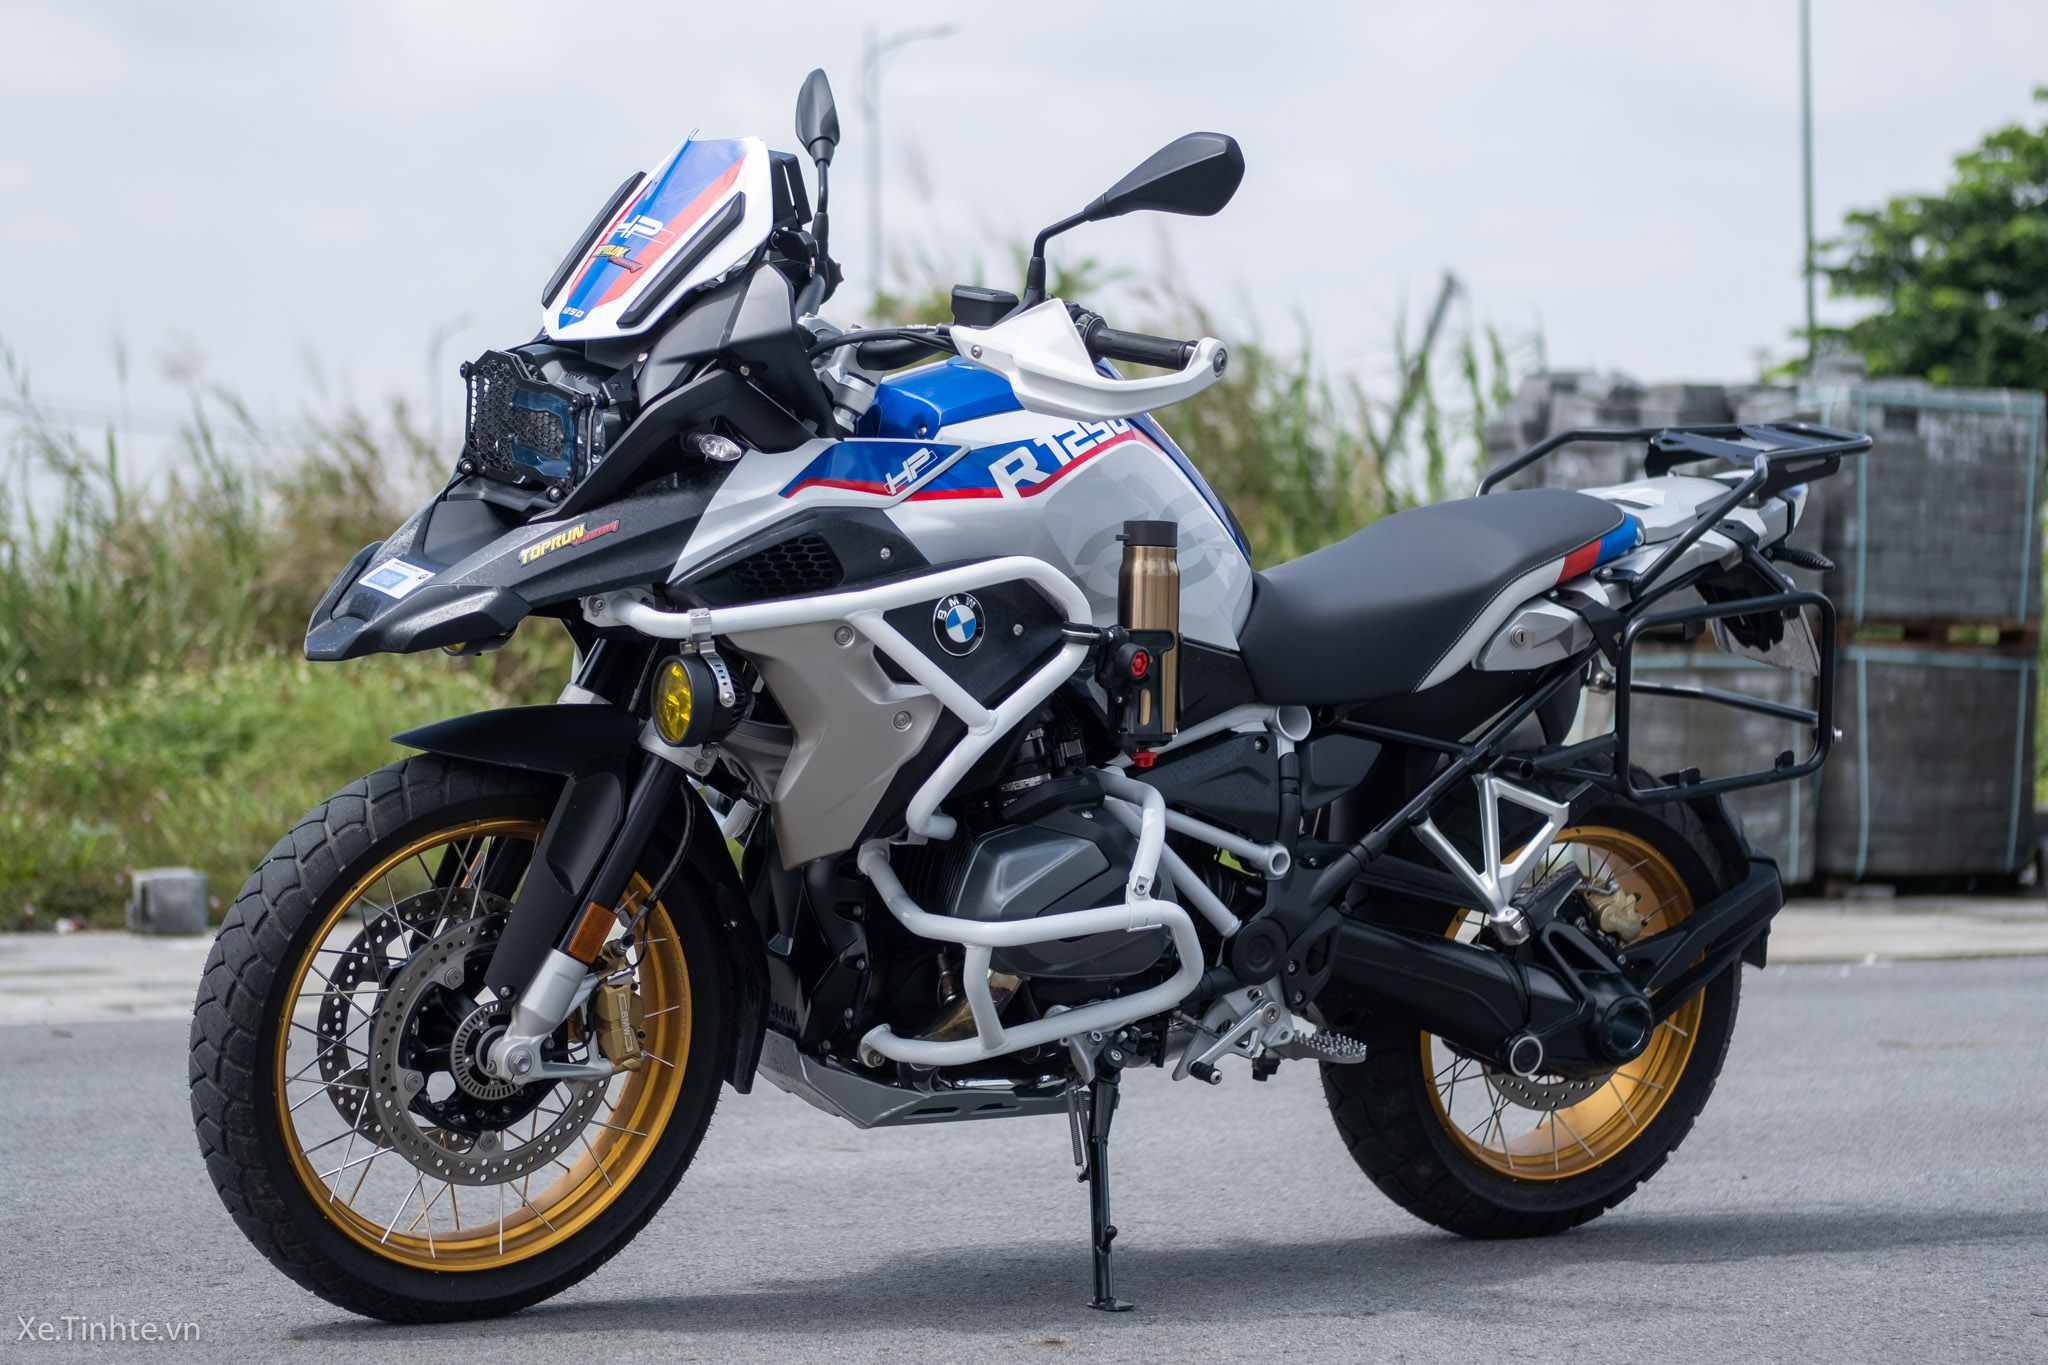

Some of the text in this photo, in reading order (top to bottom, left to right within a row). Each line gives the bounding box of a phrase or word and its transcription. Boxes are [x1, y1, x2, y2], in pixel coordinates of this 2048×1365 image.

[885, 447, 930, 495] HP
[988, 445, 1051, 498] R
[520, 524, 585, 565] TOPRUN
[937, 595, 976, 621] BMW
[621, 1011, 632, 1036] BMW
